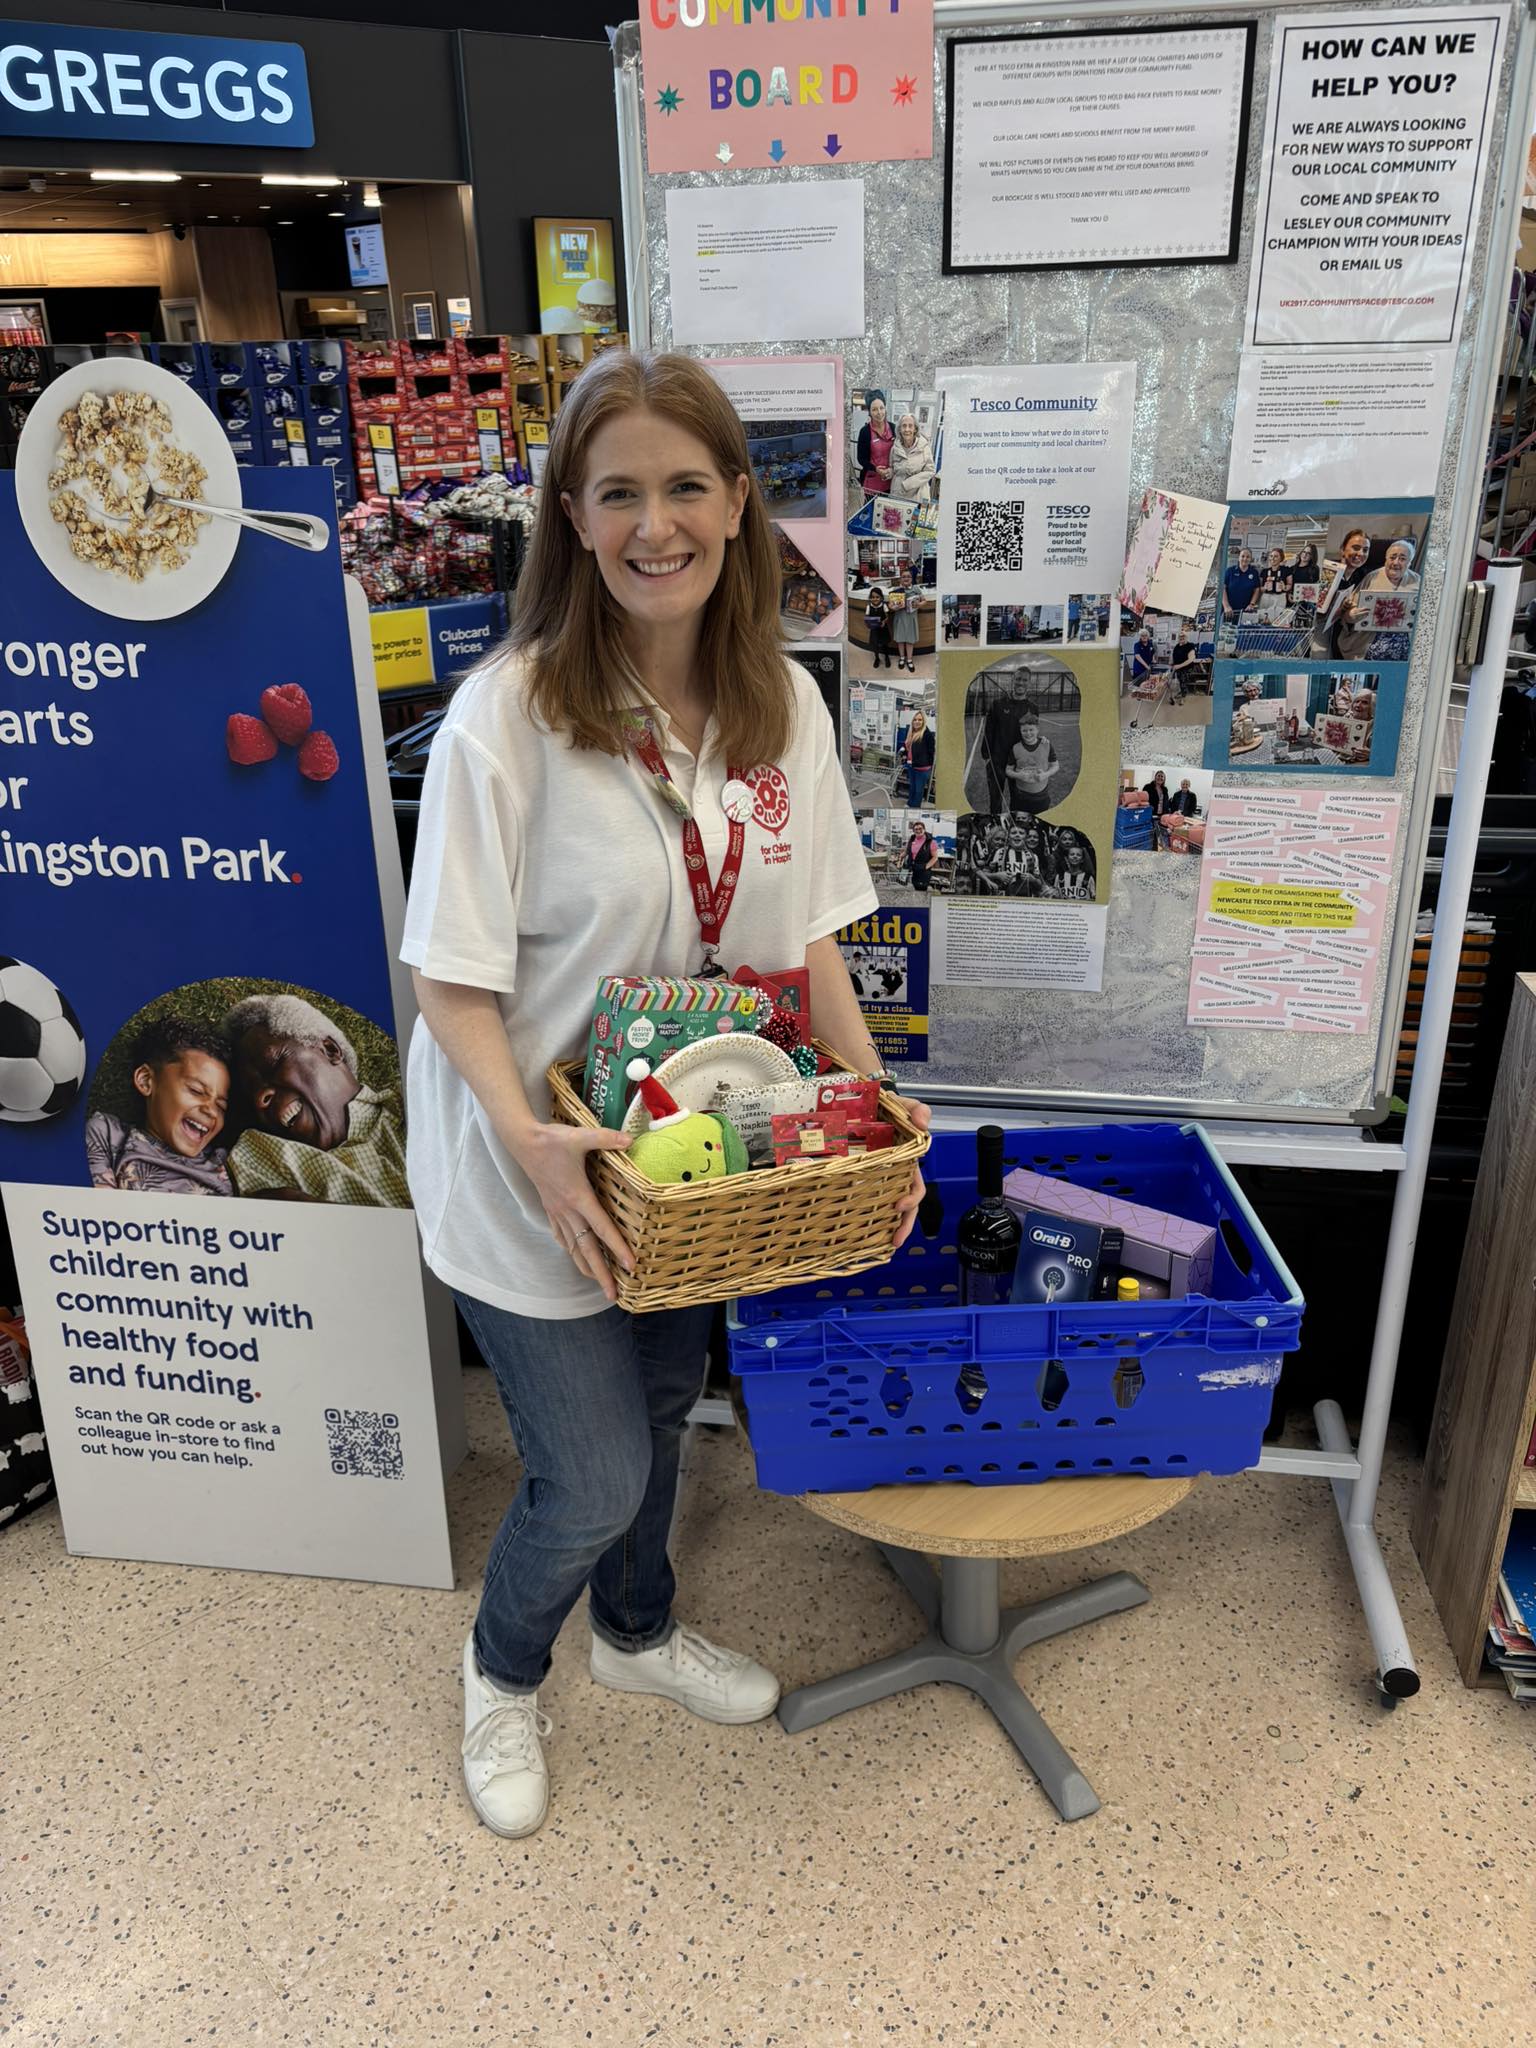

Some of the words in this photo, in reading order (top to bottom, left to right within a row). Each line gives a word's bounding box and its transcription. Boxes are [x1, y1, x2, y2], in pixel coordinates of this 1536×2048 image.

[1302, 39, 1363, 60] HOW
[1371, 35, 1426, 57] CAN
[1435, 33, 1476, 54] WE
[0, 44, 294, 124] GREGGS
[709, 64, 858, 110] BOARD
[1312, 77, 1378, 97] HELP
[1388, 74, 1457, 94] YOU?
[1292, 123, 1313, 135] WE
[1316, 122, 1343, 134] ARE
[1346, 120, 1399, 133] ALWAYS
[1403, 118, 1466, 131] LOOKING
[1282, 144, 1308, 156] FOR
[1312, 143, 1344, 155] NEW
[1347, 141, 1384, 154] WAYS
[1387, 141, 1404, 152] TO
[1408, 139, 1473, 151] SUPPORT
[1292, 164, 1321, 176] OUR
[1324, 163, 1367, 175] LOCAL
[1371, 160, 1456, 173] COMMUNITY
[1300, 194, 1340, 206] COME
[1343, 193, 1372, 205] AND
[1375, 192, 1418, 204] SPEAK
[1422, 191, 1439, 203] TO
[1284, 218, 1331, 230] LESLEY
[1334, 217, 1362, 228] OUR
[1366, 215, 1451, 228] COMMUNITY
[560, 234, 588, 250] NEW
[1268, 238, 1340, 250] CHAMPION
[1344, 237, 1378, 248] WITH
[1382, 235, 1418, 247] YOUR
[1422, 234, 1463, 246] IDEAS
[1320, 260, 1338, 271] OR
[1341, 259, 1380, 271] EMAIL
[1384, 259, 1402, 269] US
[970, 398, 1010, 411] Tesco
[1015, 396, 1098, 411] Community
[968, 431, 982, 439] you
[959, 442, 986, 450] support
[1001, 440, 1041, 448] community
[998, 467, 1008, 475] QR
[1248, 486, 1280, 496] anchor
[1047, 505, 1090, 514] TESCO
[439, 625, 490, 642] Clubcard
[384, 640, 411, 650] power
[448, 641, 482, 656] Prices
[395, 649, 422, 661] prices
[0, 641, 146, 690] onger
[761, 845, 770, 854] for
[0, 829, 170, 887] ingston
[181, 836, 303, 884] Park.
[764, 856, 771, 864] in
[1060, 887, 1087, 898] RNID
[1274, 890, 1322, 898] ORGANISATIONS
[1314, 902, 1354, 910] COMMUNITY
[871, 1004, 881, 1012] try
[590, 1049, 604, 1108] FESTIVE
[602, 1064, 610, 1080] 12
[741, 1121, 772, 1132] Napkins
[42, 1210, 221, 1254] Supporting
[228, 1229, 284, 1253] our
[1032, 1230, 1072, 1248] Oral-B
[49, 1249, 179, 1282] children
[190, 1262, 249, 1288] and
[1066, 1254, 1092, 1269] PRO
[56, 1291, 233, 1330] community
[243, 1302, 313, 1330] with
[61, 1322, 176, 1362] healthy
[186, 1331, 259, 1362] food
[69, 1362, 126, 1387] and
[135, 1363, 261, 1404] funding.
[75, 1406, 112, 1422] Scan
[116, 1410, 143, 1423] the
[147, 1412, 171, 1426] QR
[175, 1416, 215, 1430] code
[219, 1420, 236, 1431] or
[241, 1421, 267, 1434] ask
[272, 1424, 281, 1435] a
[78, 1425, 152, 1443] colleague
[156, 1429, 219, 1447] in-store
[223, 1435, 240, 1449] to
[244, 1437, 275, 1452] find
[81, 1443, 107, 1455] out
[112, 1443, 144, 1458] how
[149, 1449, 177, 1462] you
[181, 1451, 210, 1464] can
[214, 1451, 253, 1469] help.
